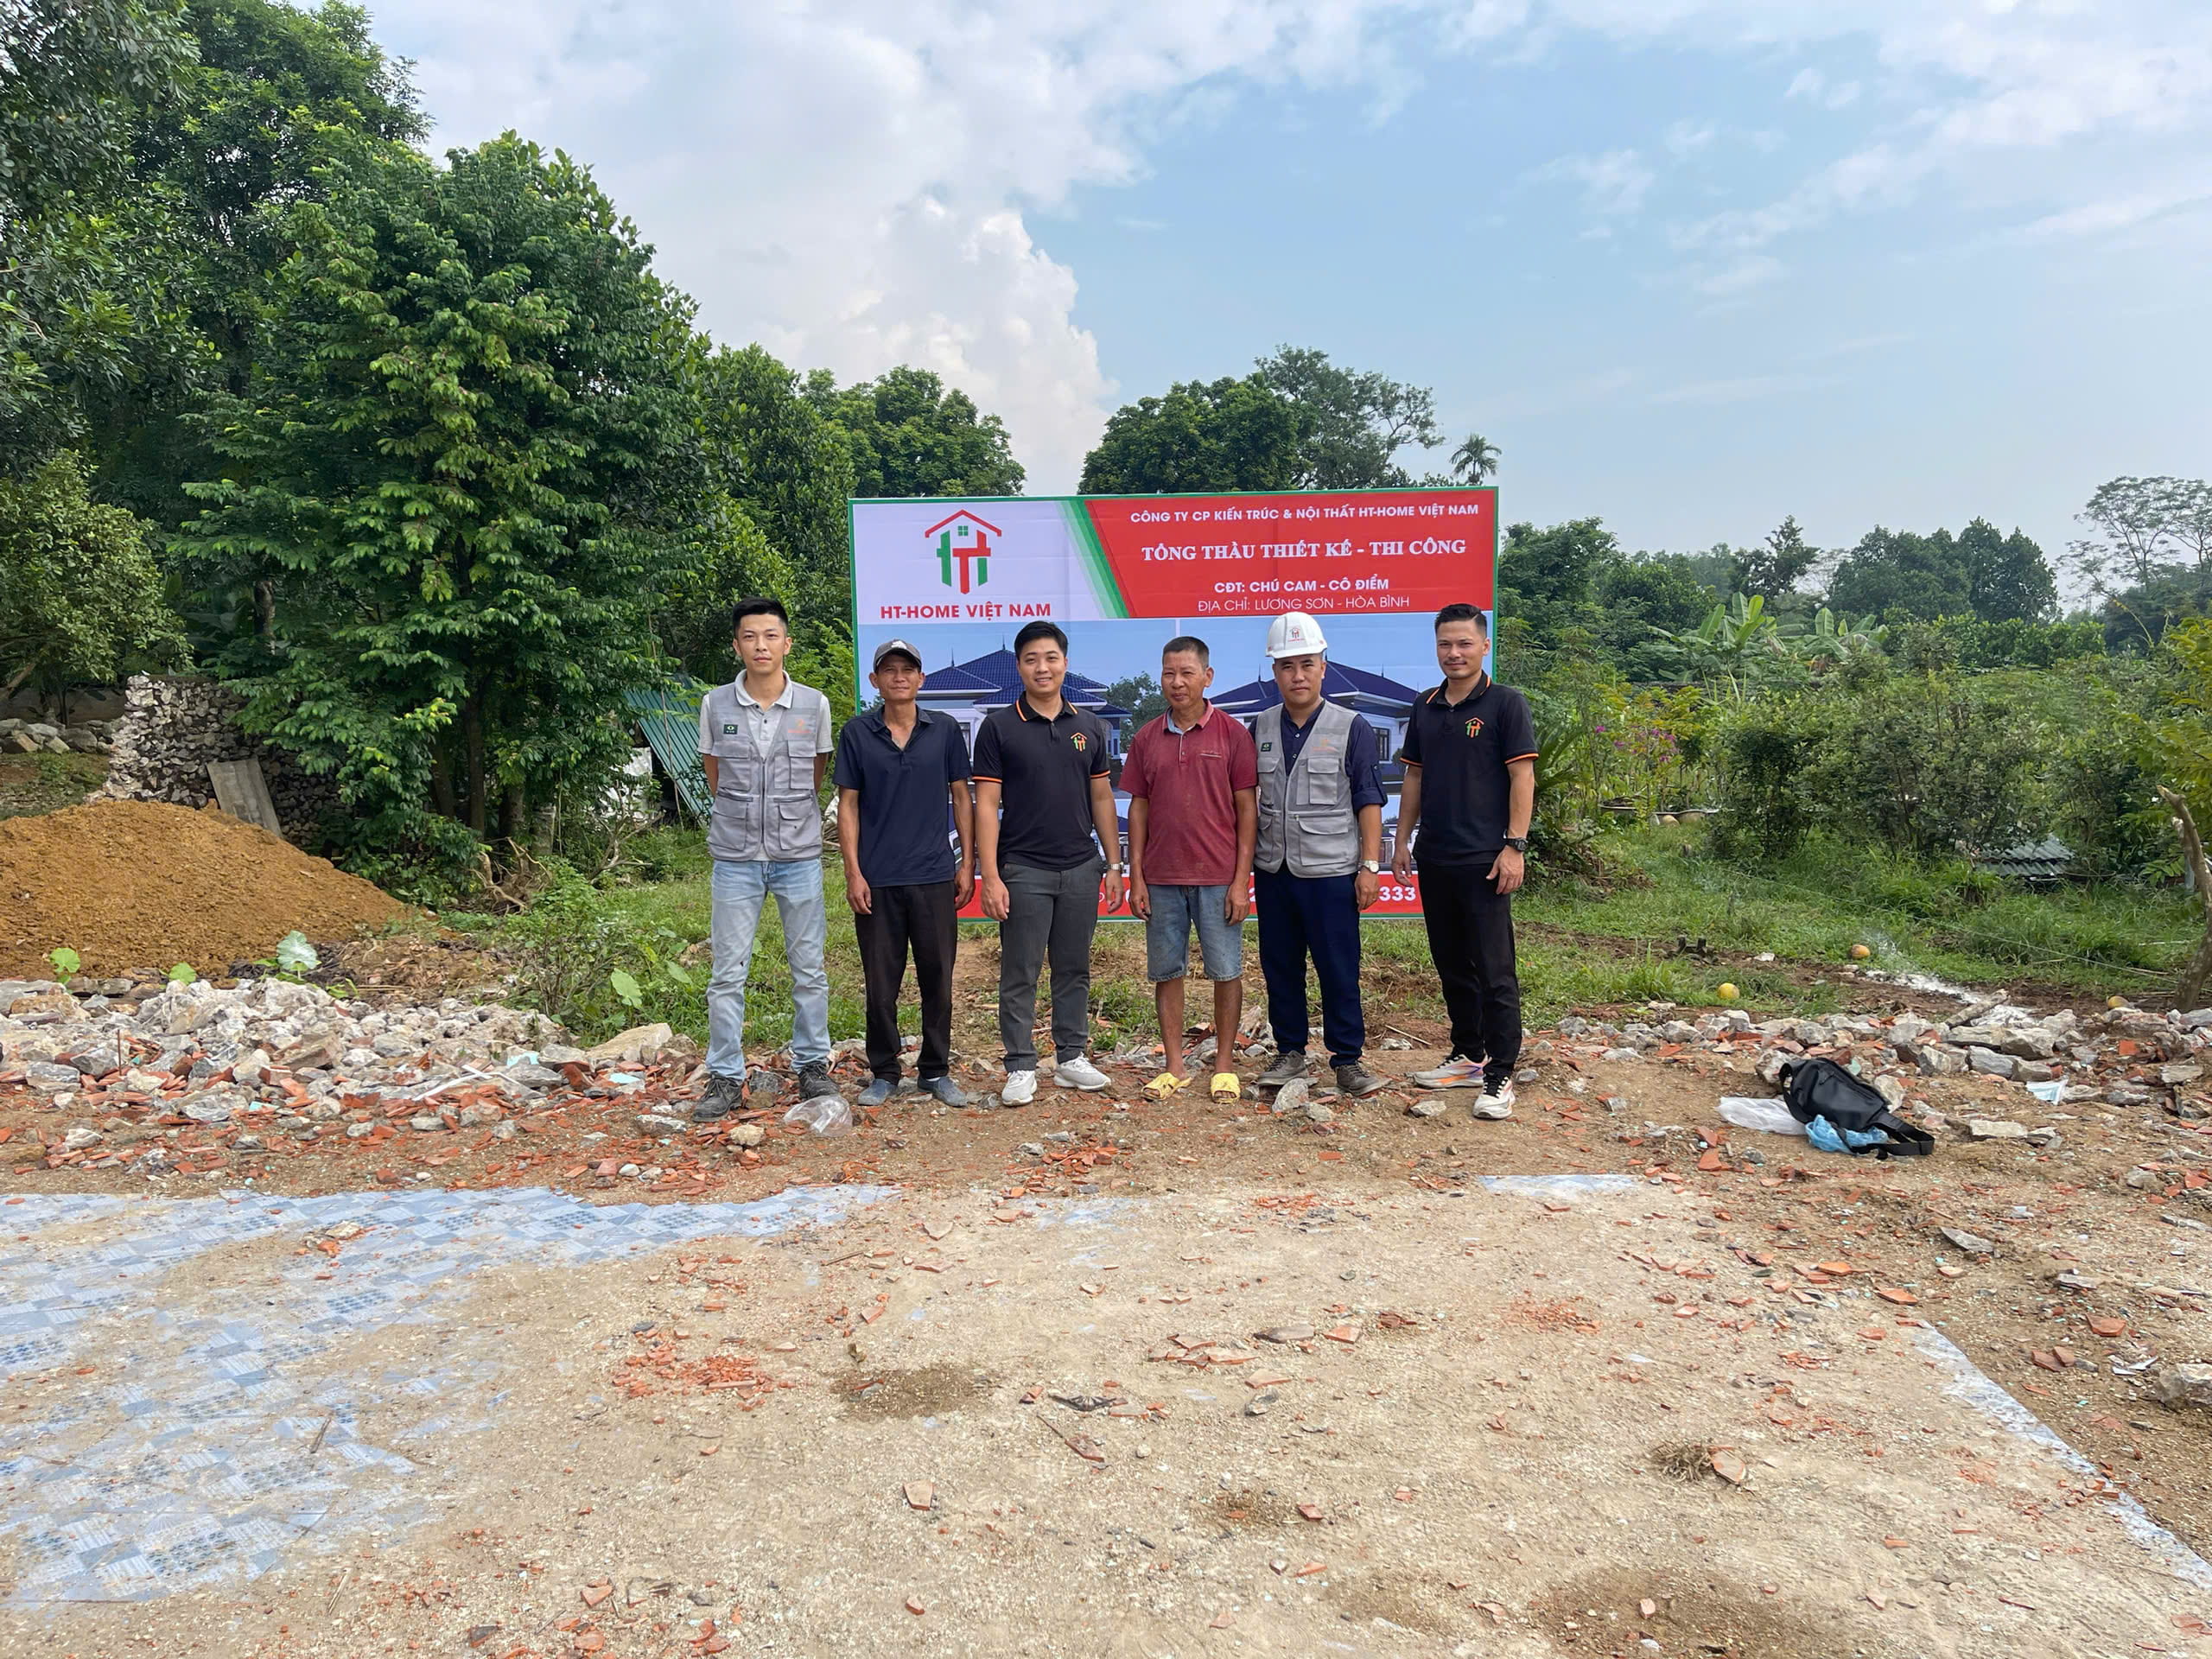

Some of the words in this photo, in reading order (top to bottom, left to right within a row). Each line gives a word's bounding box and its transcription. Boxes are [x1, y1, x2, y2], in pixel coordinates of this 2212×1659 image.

[1130, 510, 1171, 523] CÔNG
[1174, 511, 1189, 522] TY
[1192, 511, 1211, 521] CP
[1214, 506, 1243, 521] KIẾN
[1246, 507, 1279, 520] TRÚC
[1283, 509, 1293, 519] &
[1296, 505, 1320, 521] NỘI
[1324, 504, 1356, 518] THẤT
[1358, 505, 1414, 518] HT-HOME
[1419, 503, 1445, 518] VIỆT
[1448, 504, 1479, 515] NAM
[1369, 541, 1404, 556] THI
[1408, 537, 1466, 556] CÔNG
[1214, 582, 1245, 594] CĐT:
[1249, 578, 1279, 593] CHÚ
[1283, 580, 1317, 592] CAM
[1328, 576, 1351, 591] CÔ
[1355, 574, 1389, 591] ĐIỂM
[880, 605, 959, 619] HT-HOME
[966, 601, 1002, 621] VIỆT
[1009, 603, 1051, 617] NAM
[1198, 600, 1221, 613] ĐỊA
[1224, 596, 1250, 611] CHỈ:
[1255, 598, 1302, 610] LƯƠNG
[1306, 597, 1334, 609] SƠN
[1345, 595, 1376, 608] HÒA
[1380, 594, 1410, 607] BÌNH
